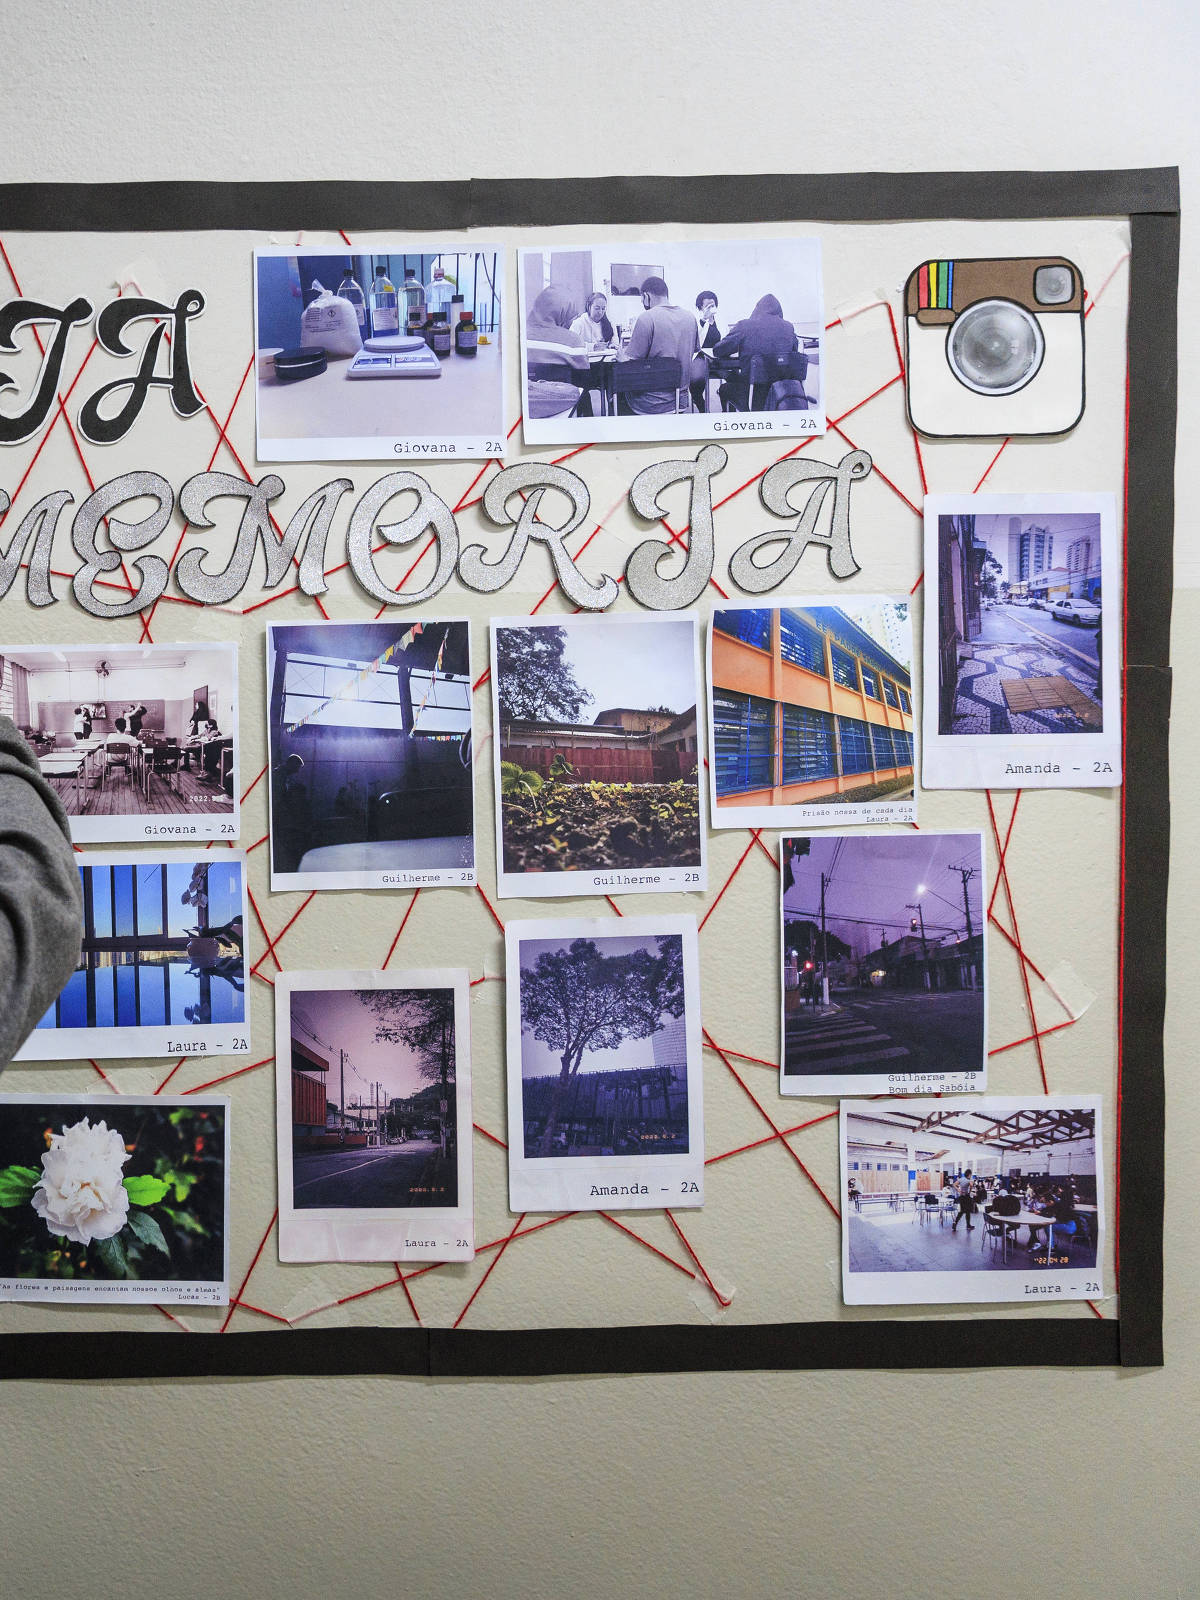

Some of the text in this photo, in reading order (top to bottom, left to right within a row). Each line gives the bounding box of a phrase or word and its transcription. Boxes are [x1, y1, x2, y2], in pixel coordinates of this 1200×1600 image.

[713, 420, 773, 432] Giovana
[800, 418, 817, 429] 2A
[393, 441, 457, 454] Giovana
[485, 441, 503, 452] 2A
[1004, 762, 1061, 774] Amanda
[1093, 761, 1113, 773] 2A
[144, 825, 197, 835] Giovana
[220, 824, 235, 833] 2A
[381, 874, 441, 883] Guilherme
[460, 872, 474, 881] 2B
[593, 875, 661, 886] Guilherme
[684, 873, 700, 882] 2B
[167, 1041, 207, 1053] Laura
[232, 1038, 248, 1050] 2A
[887, 1073, 946, 1083] Guilherme
[964, 1072, 977, 1080] 2B
[888, 1083, 976, 1094] Bom dia Sabóia
[589, 1183, 649, 1196] Amanda
[680, 1181, 700, 1193] 2A
[404, 1239, 437, 1248] Laura
[456, 1239, 469, 1247] 2A
[1024, 1284, 1062, 1294] Laura
[1085, 1282, 1100, 1292] 2A
